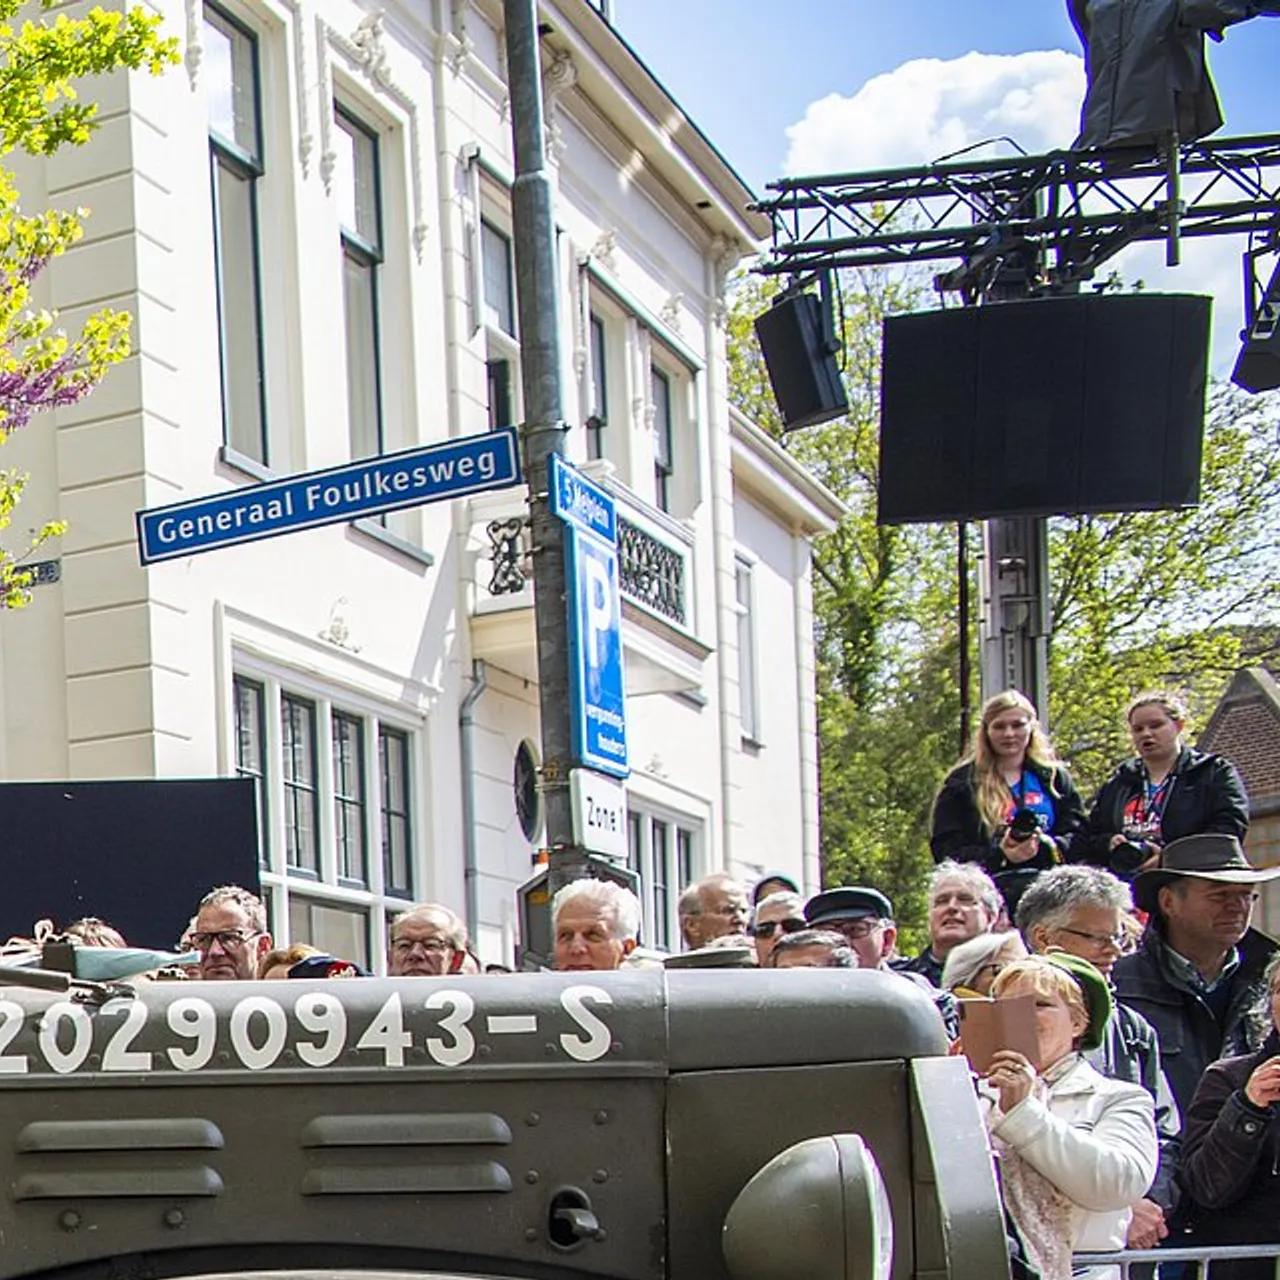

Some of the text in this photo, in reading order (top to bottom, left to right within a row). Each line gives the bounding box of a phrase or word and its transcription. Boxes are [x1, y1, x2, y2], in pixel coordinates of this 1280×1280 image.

[156, 449, 497, 545] Generaal Foulkesweg
[586, 554, 612, 668] P
[586, 796, 616, 832] Zone
